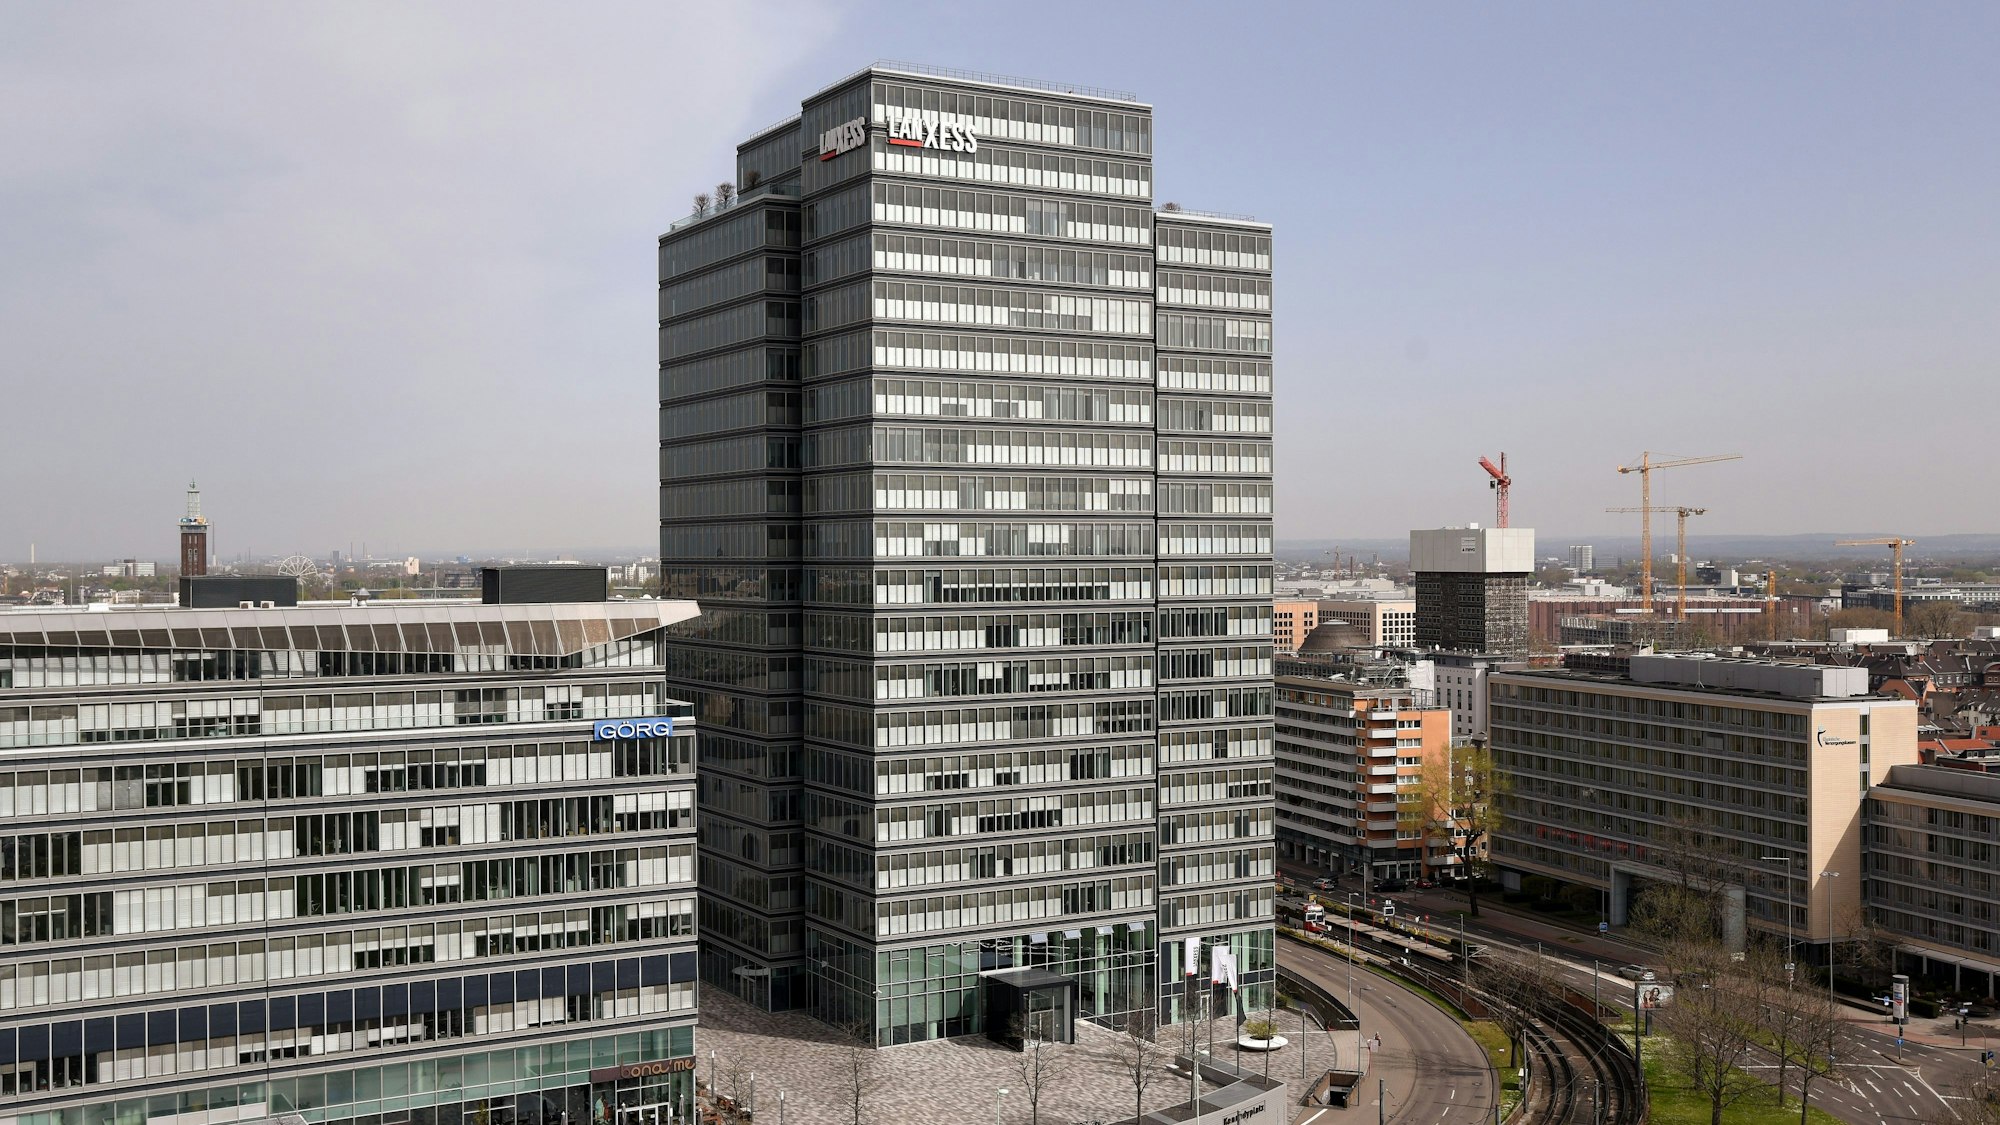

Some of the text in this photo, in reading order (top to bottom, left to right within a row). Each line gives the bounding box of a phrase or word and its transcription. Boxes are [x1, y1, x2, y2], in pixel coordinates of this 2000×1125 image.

[819, 116, 866, 156] LANXESS
[888, 113, 978, 153] LANXESS
[600, 721, 669, 739] GÖRG
[620, 1055, 696, 1079] bona'me
